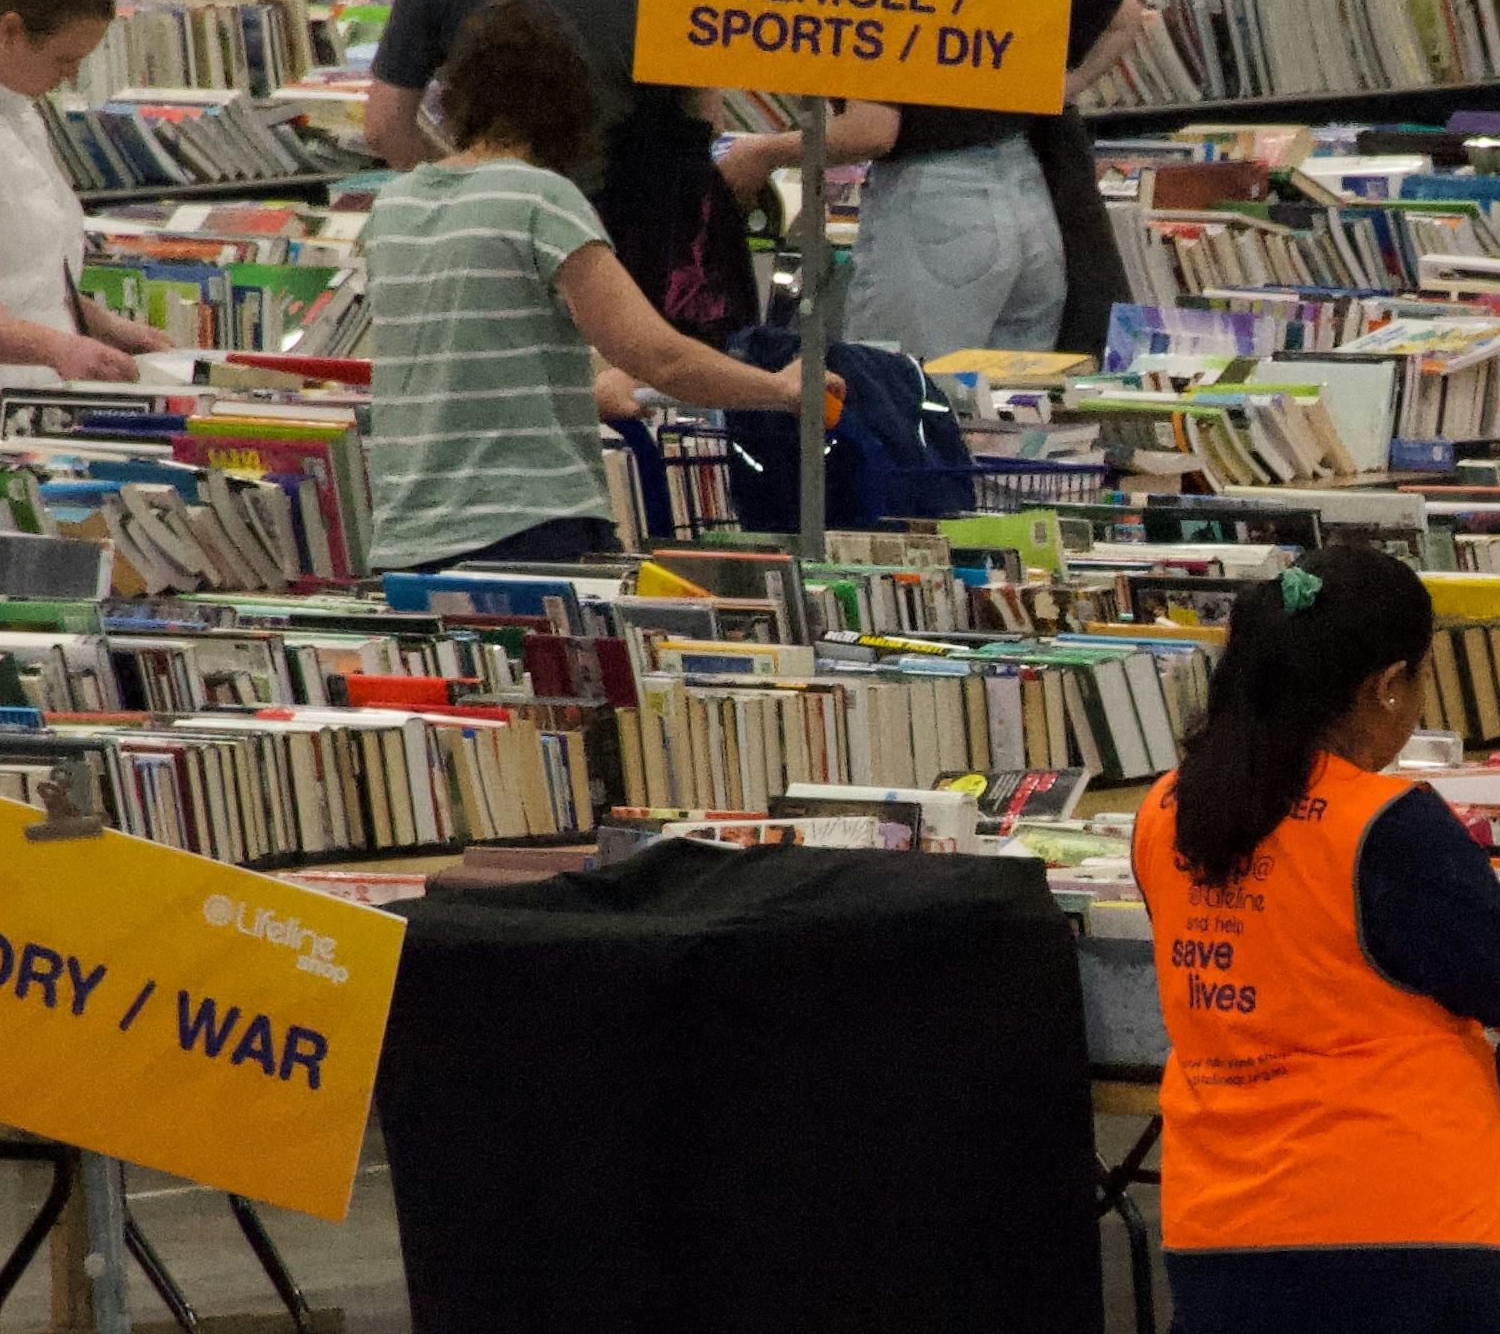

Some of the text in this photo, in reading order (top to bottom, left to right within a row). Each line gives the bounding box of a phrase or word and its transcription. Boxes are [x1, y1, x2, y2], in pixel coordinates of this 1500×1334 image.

[687, 5, 1014, 70] SPORTS / DIY
[235, 899, 339, 962] Lifeline
[1214, 915, 1245, 935] help
[295, 954, 349, 985] shop
[1171, 938, 1234, 971] save
[1188, 972, 1258, 1014] lives
[118, 979, 157, 1033] /
[175, 988, 330, 1091] WAR
